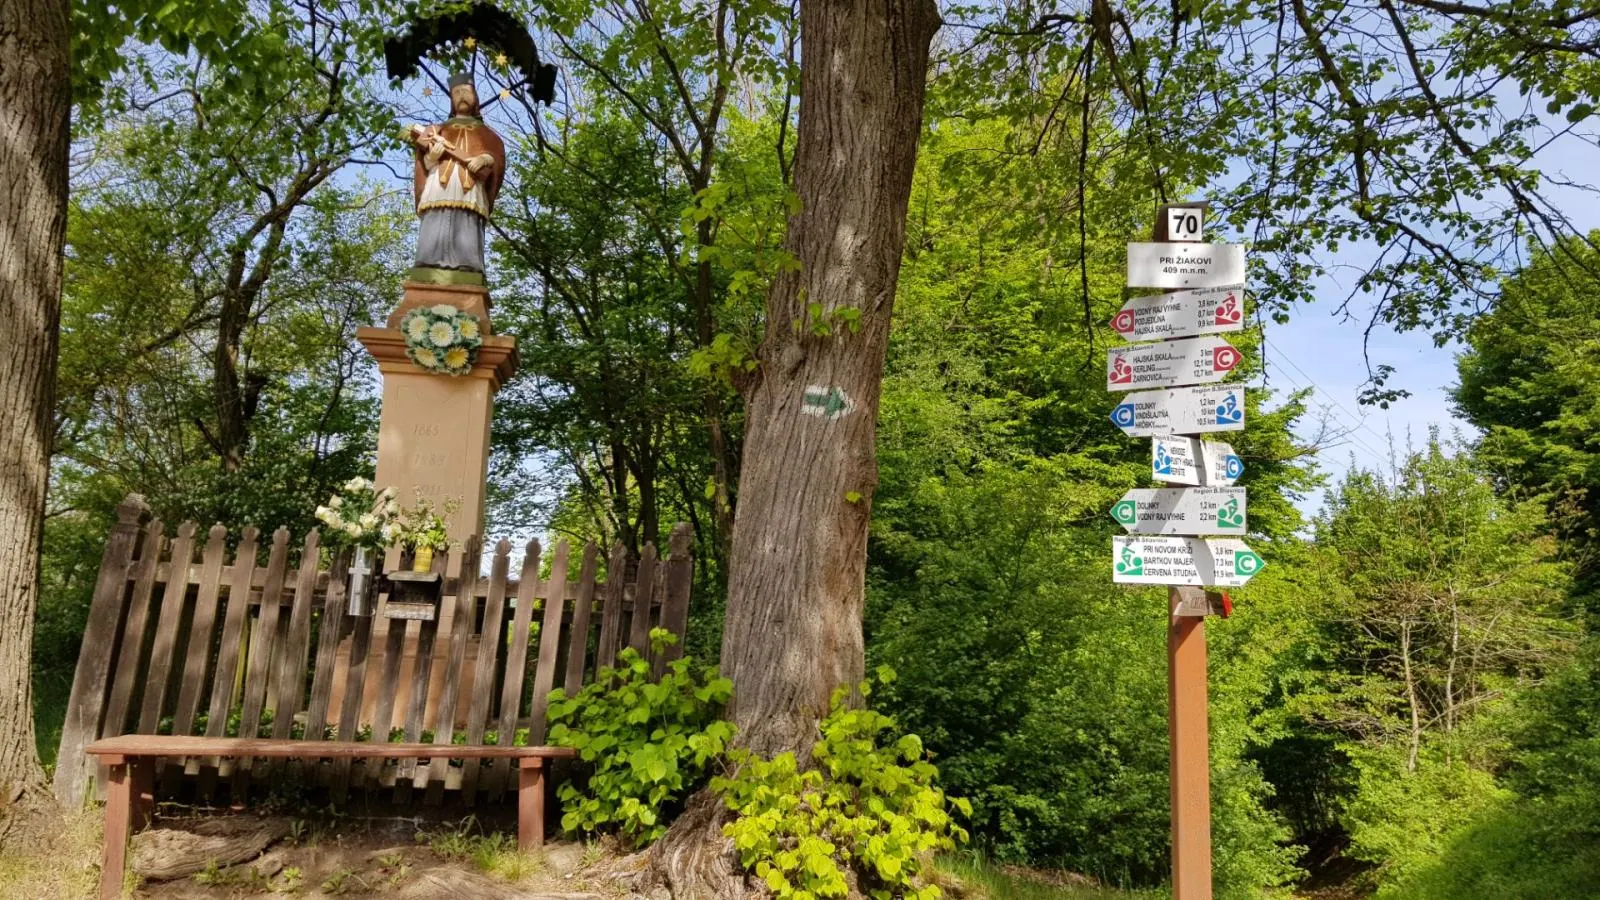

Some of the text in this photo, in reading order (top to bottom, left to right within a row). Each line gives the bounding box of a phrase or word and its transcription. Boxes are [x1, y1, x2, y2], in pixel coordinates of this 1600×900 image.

[1173, 215, 1198, 234] 70
[1160, 256, 1211, 265] PRI ŽIAKOVI
[1163, 266, 1178, 274] 409
[1205, 348, 1213, 356] km
[1137, 502, 1160, 510] DOLINKY
[1208, 501, 1216, 509] km
[1156, 512, 1167, 520] RAJ
[1167, 512, 1185, 520] VYHNE
[1208, 512, 1216, 520] km
[1143, 546, 1153, 554] PRI
[1154, 546, 1177, 554] NOVOM
[1224, 547, 1233, 555] km
[1143, 556, 1194, 566] BARTKOV MAJER
[1224, 558, 1234, 566] km
[1143, 568, 1172, 577] ČERVENÁ
[1225, 570, 1234, 578] km
